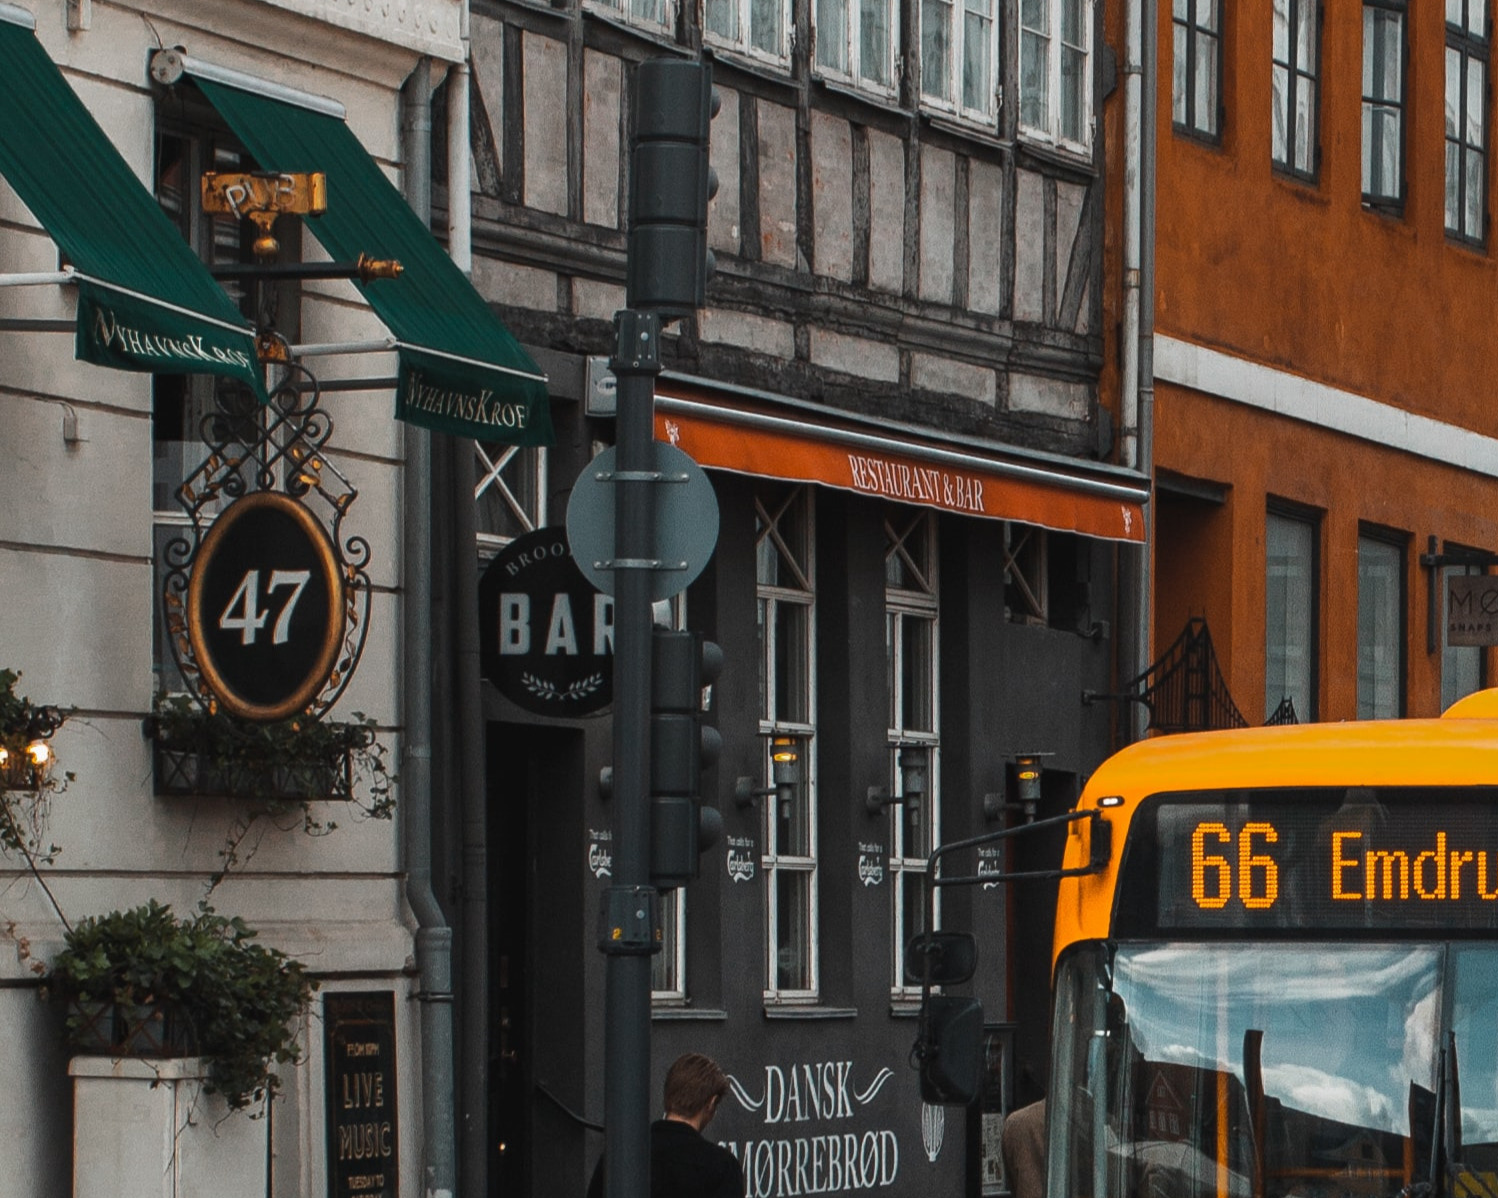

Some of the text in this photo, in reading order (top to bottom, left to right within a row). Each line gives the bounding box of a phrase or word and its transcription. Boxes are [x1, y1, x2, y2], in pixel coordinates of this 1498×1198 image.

[226, 174, 295, 220] PUB
[848, 454, 984, 512] RESTAURANT & BAR
[505, 542, 569, 577] BROO
[219, 569, 311, 645] 47
[499, 593, 615, 655] BAR
[1450, 623, 1492, 633] SNAPS
[589, 844, 612, 873] Carlsbe
[1192, 823, 1278, 908] 66
[343, 1072, 384, 1108] LIVE
[764, 1061, 853, 1123] DANSK
[338, 1121, 391, 1160] MUSIC
[348, 1175, 375, 1190] TUESDAY
[718, 1130, 898, 1198] MØRREBRØD
